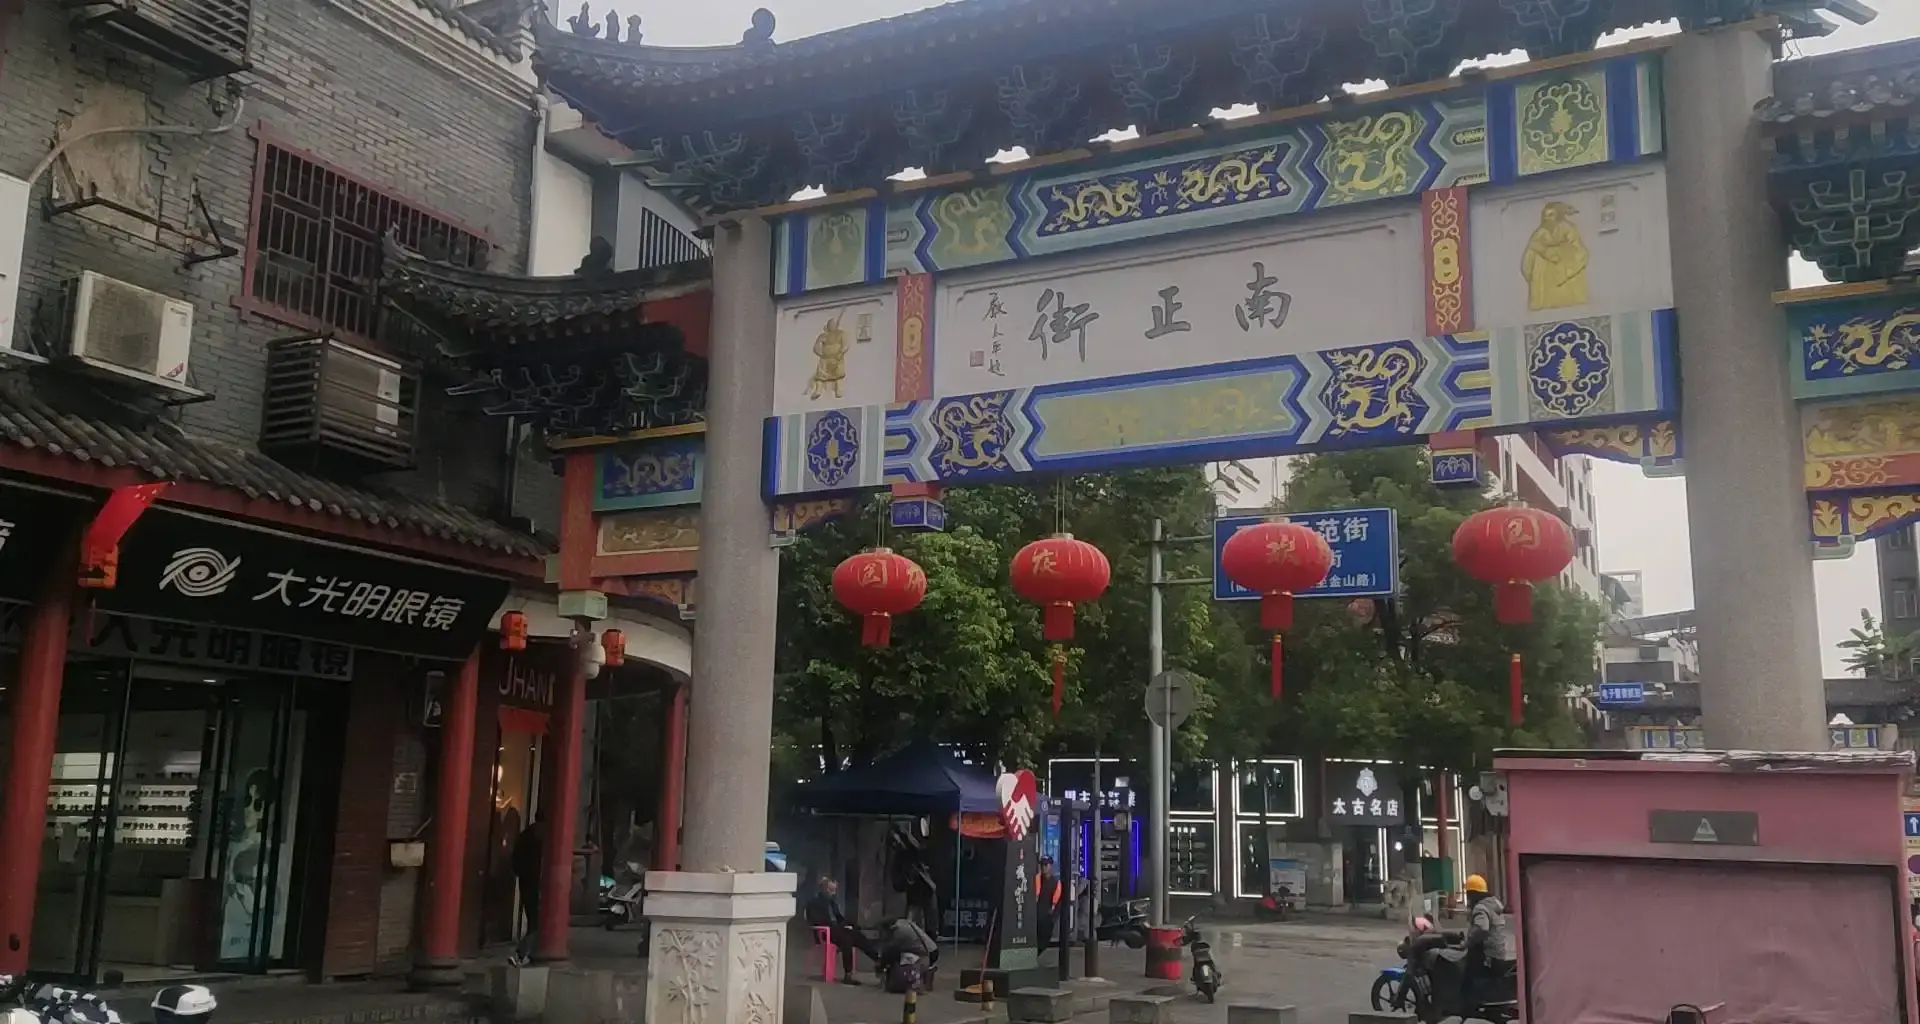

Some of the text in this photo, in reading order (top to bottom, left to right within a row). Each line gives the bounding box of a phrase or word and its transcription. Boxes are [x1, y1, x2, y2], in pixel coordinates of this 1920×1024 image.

[1028, 262, 1292, 362] 南正街
[253, 568, 465, 631] 大光明眼镜
[1332, 797, 1398, 817] 太古名店
